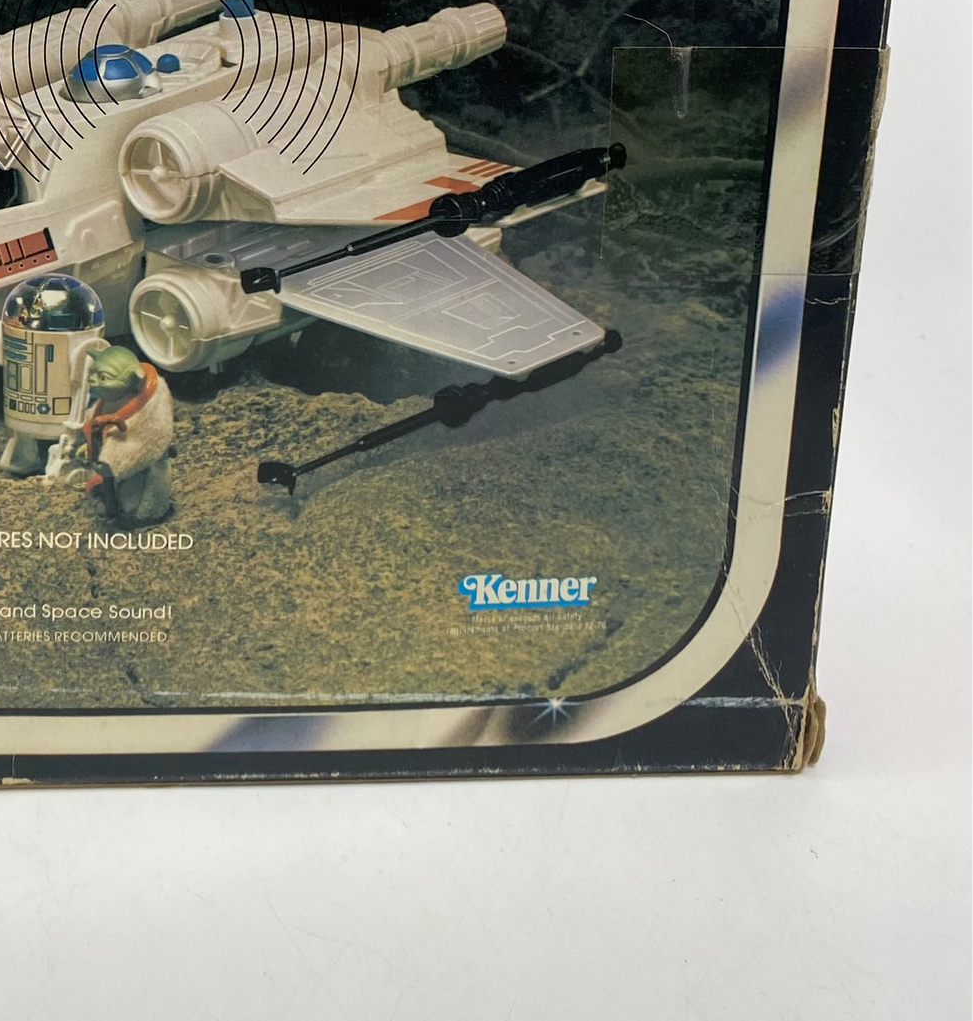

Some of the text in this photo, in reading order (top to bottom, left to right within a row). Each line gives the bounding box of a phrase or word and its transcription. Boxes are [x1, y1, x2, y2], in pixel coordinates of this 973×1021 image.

[39, 532, 82, 549] NOT
[88, 533, 193, 550] INCLUDED
[462, 574, 598, 605] Kenner
[0, 604, 36, 618] and
[42, 604, 103, 621] Space
[109, 605, 172, 619] Sound!
[54, 630, 167, 643] RECOMMENDED
